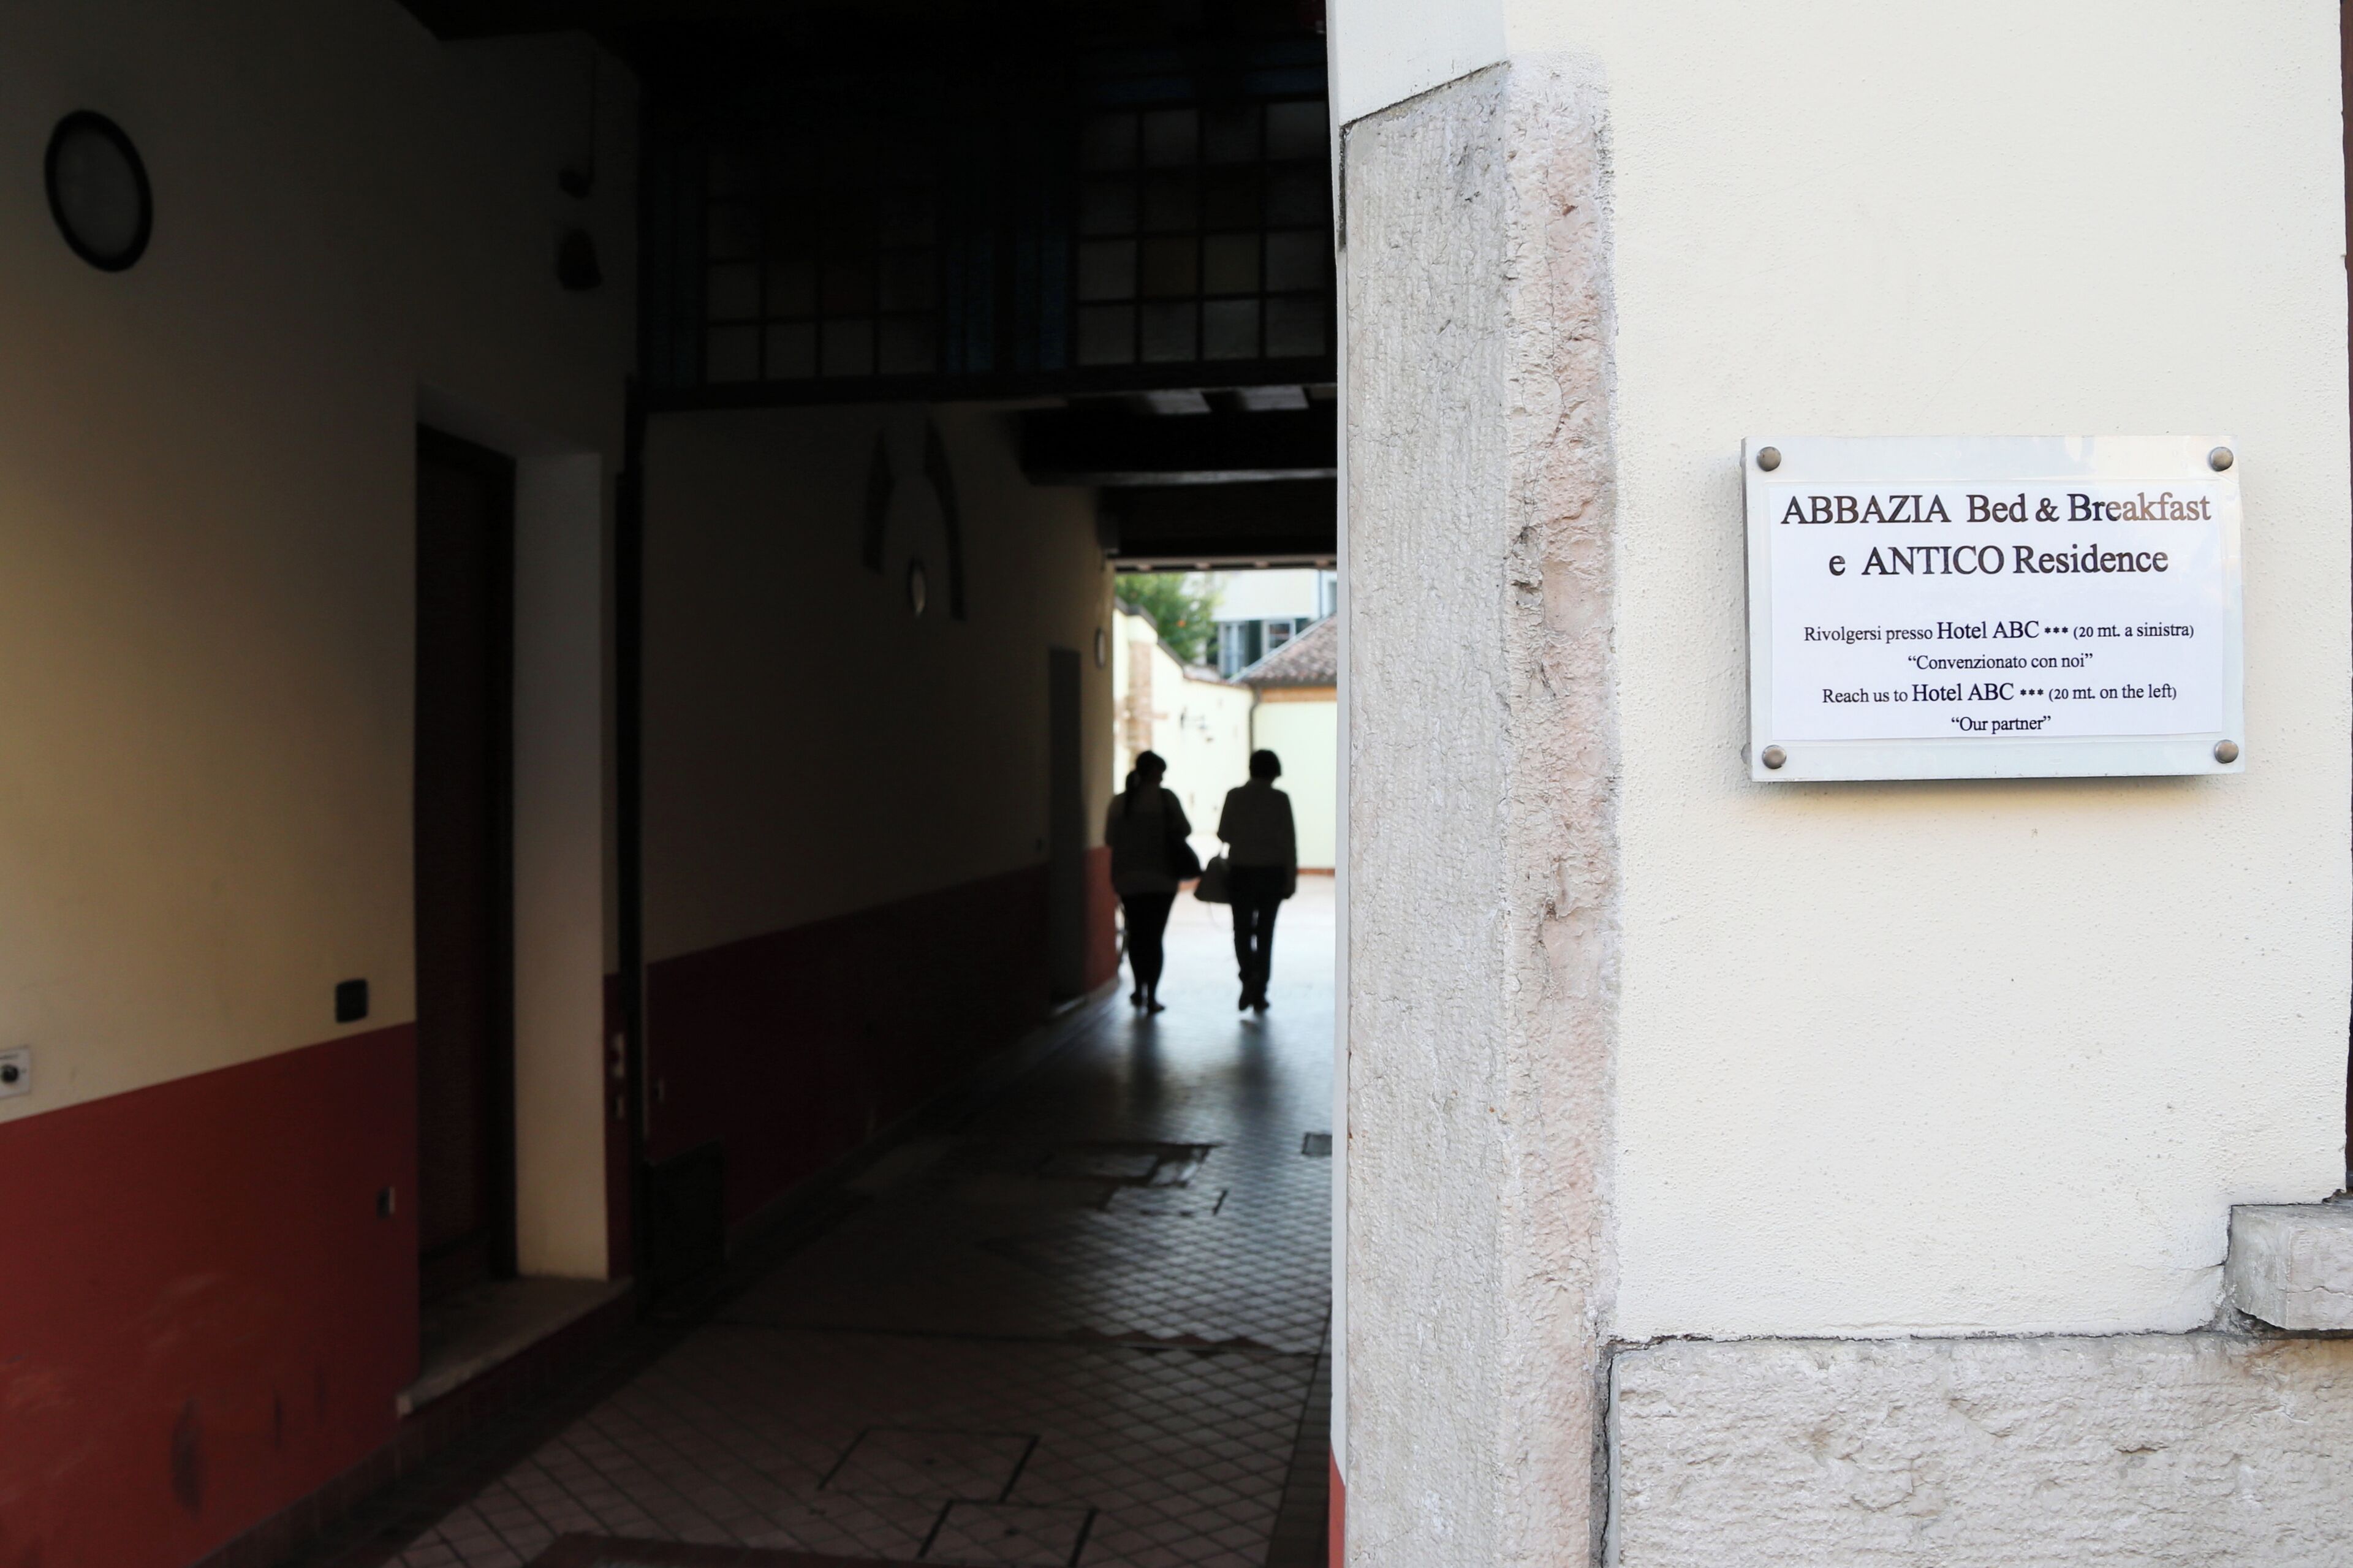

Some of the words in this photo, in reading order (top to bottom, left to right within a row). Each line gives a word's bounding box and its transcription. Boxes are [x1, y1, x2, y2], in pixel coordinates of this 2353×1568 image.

[1781, 494, 1952, 524] ABBAZIA
[1966, 493, 2028, 523] Bed
[2036, 498, 2059, 522] &
[2067, 492, 2211, 521] Breakfast
[1829, 556, 1846, 576] e
[1861, 545, 2004, 575] ANTICO
[2012, 543, 2168, 574] Residence
[1804, 626, 1882, 644] Rivolgersi
[1885, 629, 1933, 644] presso
[1936, 621, 1988, 639] Hotel
[1992, 621, 2039, 638] ABC
[2074, 627, 2093, 640] (20
[2097, 625, 2120, 637] mt.
[2125, 627, 2133, 637] a
[2137, 622, 2194, 638] sinistra)
[1908, 654, 2027, 670] “Convenzionato
[2031, 657, 2058, 668] con
[2061, 653, 2093, 667] noi”
[1822, 688, 1870, 703] Reach
[1873, 692, 1889, 702] us
[1893, 690, 1908, 702] to
[1912, 683, 1963, 701] Hotel
[1968, 683, 2014, 700] ABC
[2048, 689, 2069, 702] (20
[2072, 687, 2096, 699] mt.
[2100, 689, 2118, 699] on
[2121, 684, 2144, 699] the
[2148, 683, 2177, 700] left)
[1951, 717, 1988, 731] “Our
[1991, 716, 2051, 735] partner”
